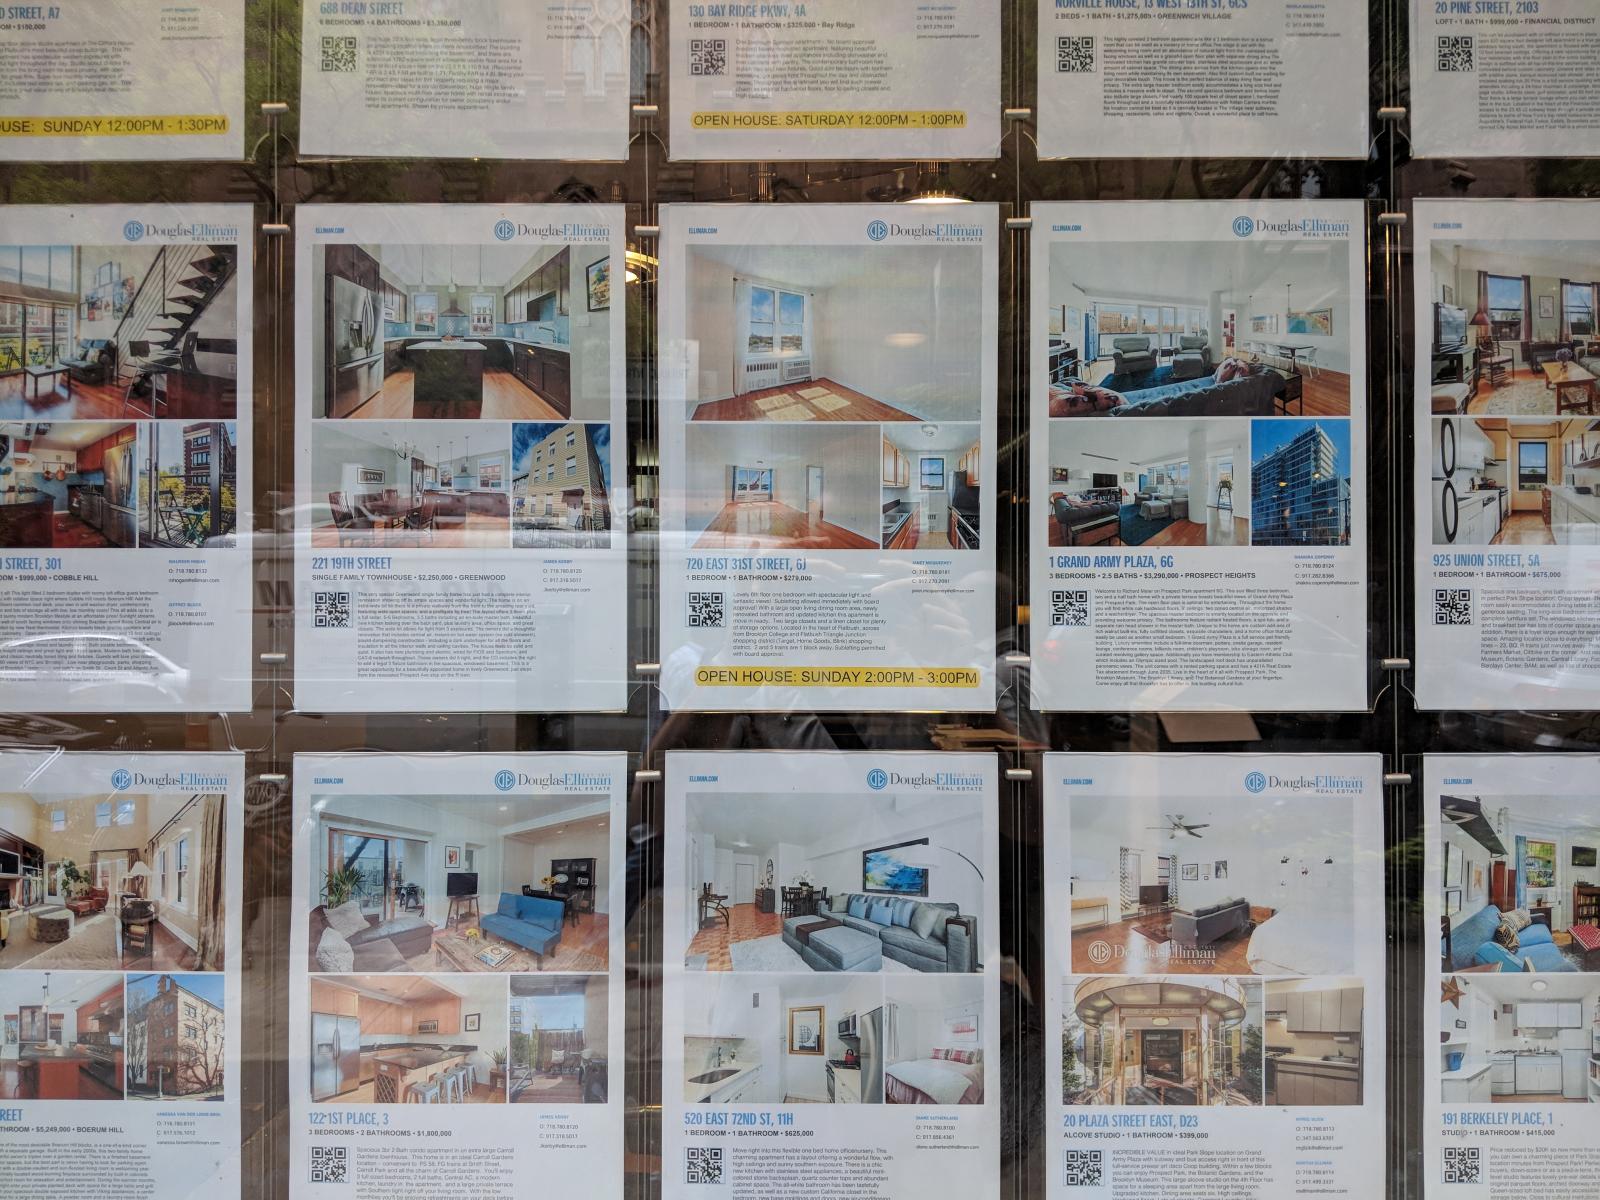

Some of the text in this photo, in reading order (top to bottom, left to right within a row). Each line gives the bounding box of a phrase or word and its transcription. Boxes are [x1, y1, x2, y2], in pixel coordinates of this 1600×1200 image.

[8, 6, 60, 21] STREET, A7
[340, 2, 367, 14] DEAN
[369, 2, 404, 14] STREET
[688, 4, 807, 19] 130 BAY RIDGE PKWY, 4A
[1435, 1, 1539, 16] 20 PINE STREET, 2103
[44, 120, 102, 132] SUNDAY
[108, 119, 164, 131] 12:00PM
[178, 118, 226, 131] 1:30PM
[694, 116, 730, 126] OPEN
[786, 115, 854, 126] SATURDAY
[859, 115, 908, 126] 12:00PM
[922, 114, 964, 125] 1:00PM
[6, 557, 61, 572] STREET, 301
[312, 557, 392, 570] 221 19TH STREET
[686, 558, 806, 572] 720 EAST 31ST STREET, 6J
[1057, 556, 1091, 568] GRAND
[1094, 556, 1121, 568] ARMY
[1124, 556, 1157, 570] PLAZA,
[1160, 556, 1174, 568] 6G
[1433, 554, 1540, 568] 925 UNION STREET, 5A
[698, 670, 976, 683] OPEN HOUSE: SUNDAY 2:00PM 3:00PM
[309, 1112, 326, 1125] 122
[328, 1112, 343, 1125] 1ST
[346, 1112, 379, 1126] PLACE,
[684, 1112, 794, 1127] 520 EAST 72ND ST, 11H
[1064, 1114, 1198, 1129] 20 PLAZA STREET EAST, D23
[1442, 1112, 1457, 1125] 191
[1460, 1112, 1508, 1125] BERKELEY
[1512, 1112, 1545, 1127] PLACE,
